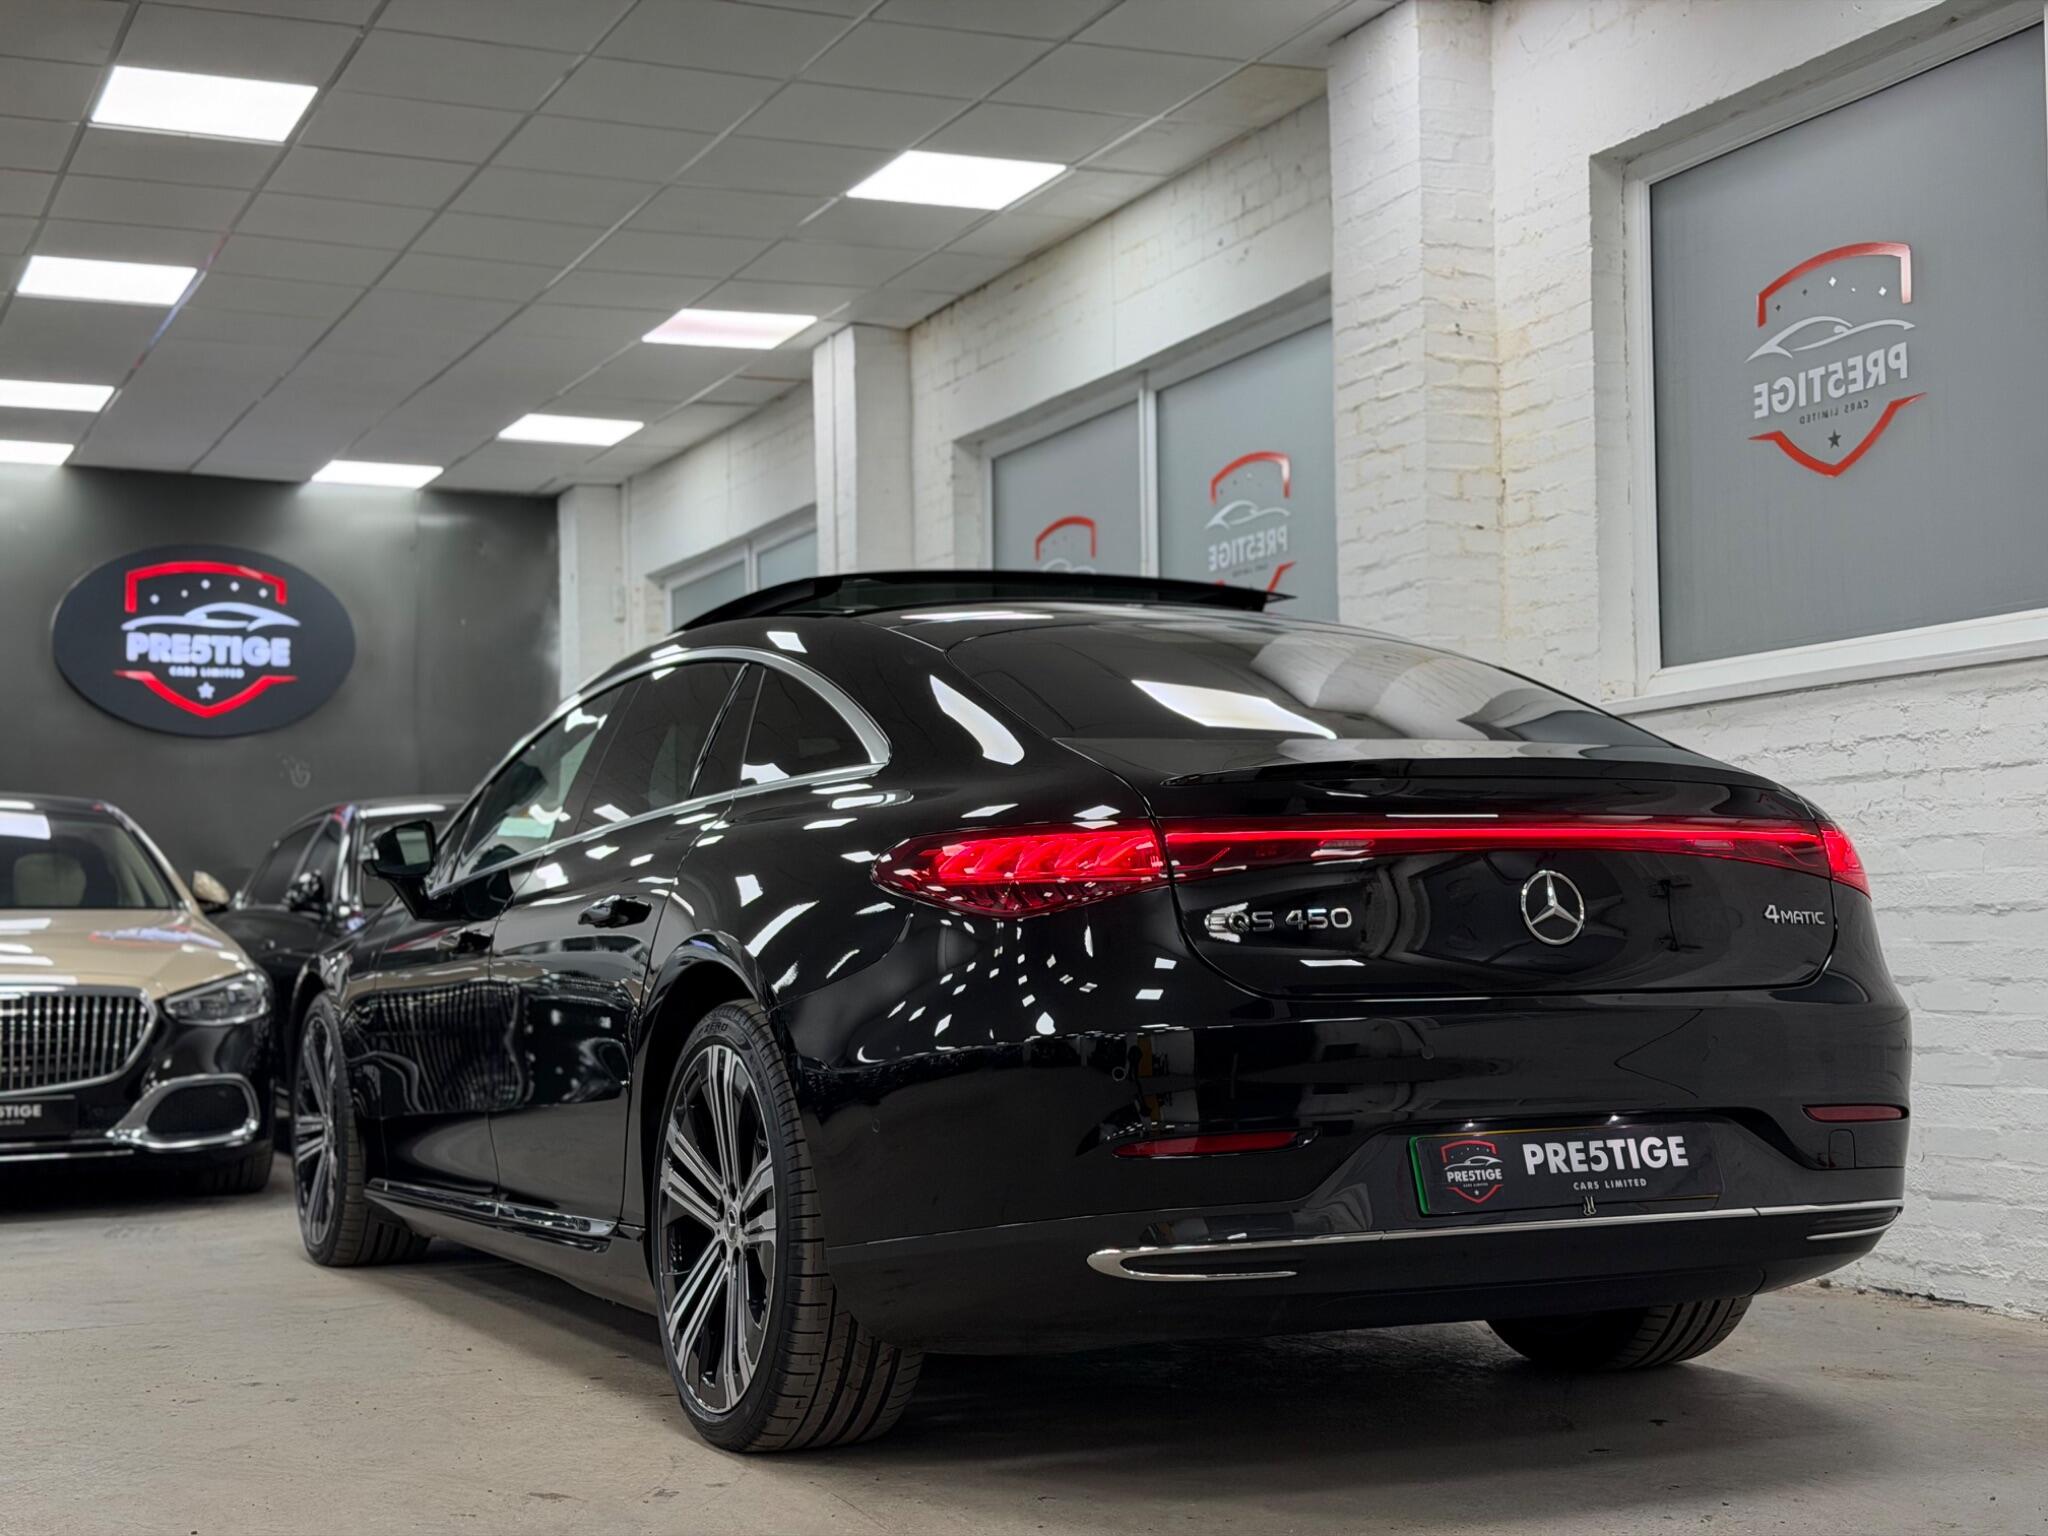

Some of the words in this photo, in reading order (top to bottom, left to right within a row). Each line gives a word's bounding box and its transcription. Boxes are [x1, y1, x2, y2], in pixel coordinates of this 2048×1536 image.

[1204, 909, 1275, 933] EQS
[1285, 907, 1352, 930] 450
[1764, 904, 1826, 924] 4MATIC
[1604, 1178, 1647, 1189] LIMITED
